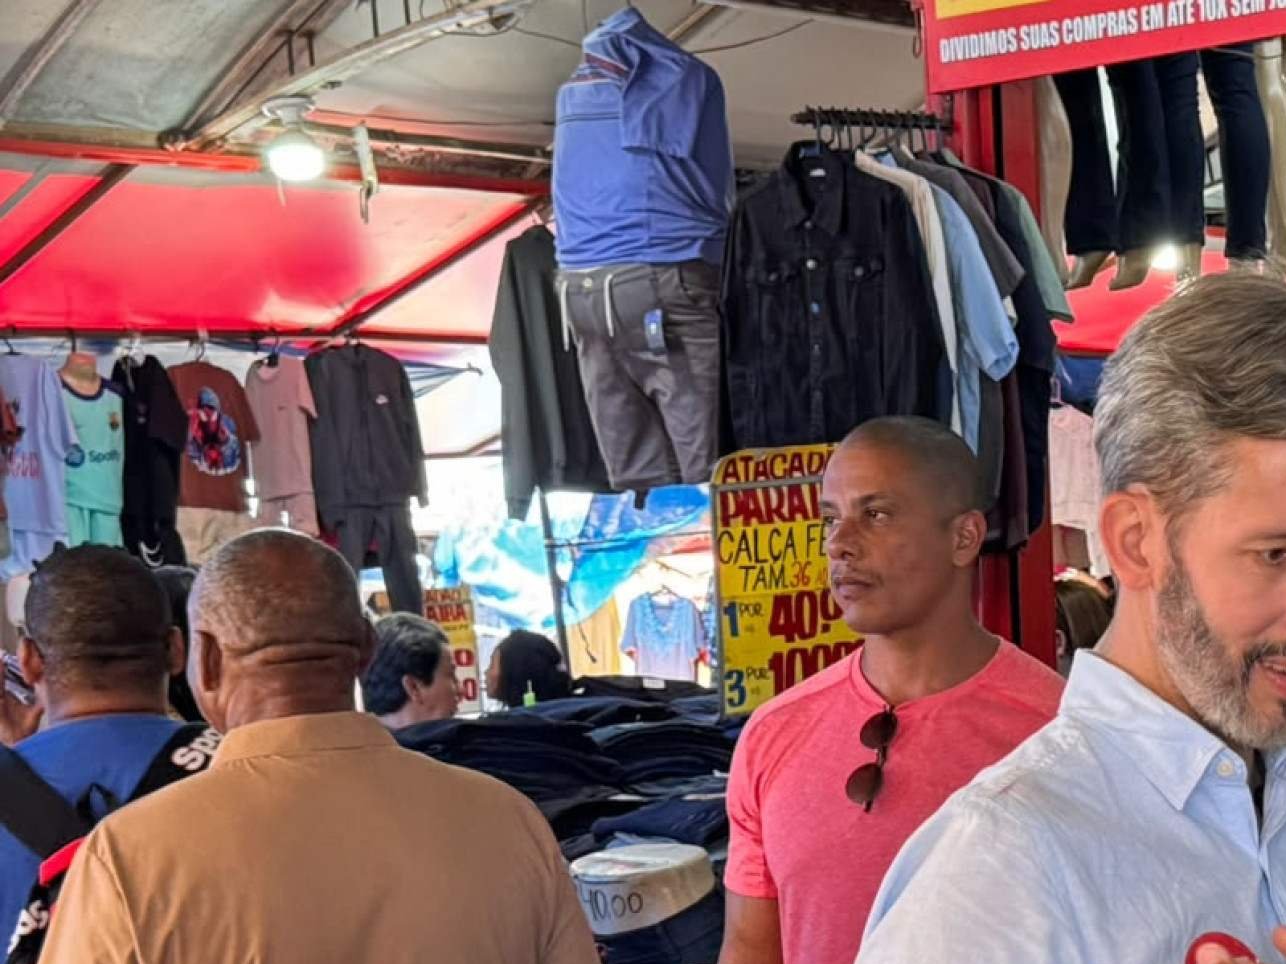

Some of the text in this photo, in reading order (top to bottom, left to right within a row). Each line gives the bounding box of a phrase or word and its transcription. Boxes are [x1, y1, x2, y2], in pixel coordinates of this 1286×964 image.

[939, 27, 1017, 63] DIVIDIMOS
[1020, 21, 1060, 50] SUAS
[1062, 7, 1138, 44] COMPRAS
[1141, 2, 1165, 32] EM
[790, 560, 813, 588] 36
